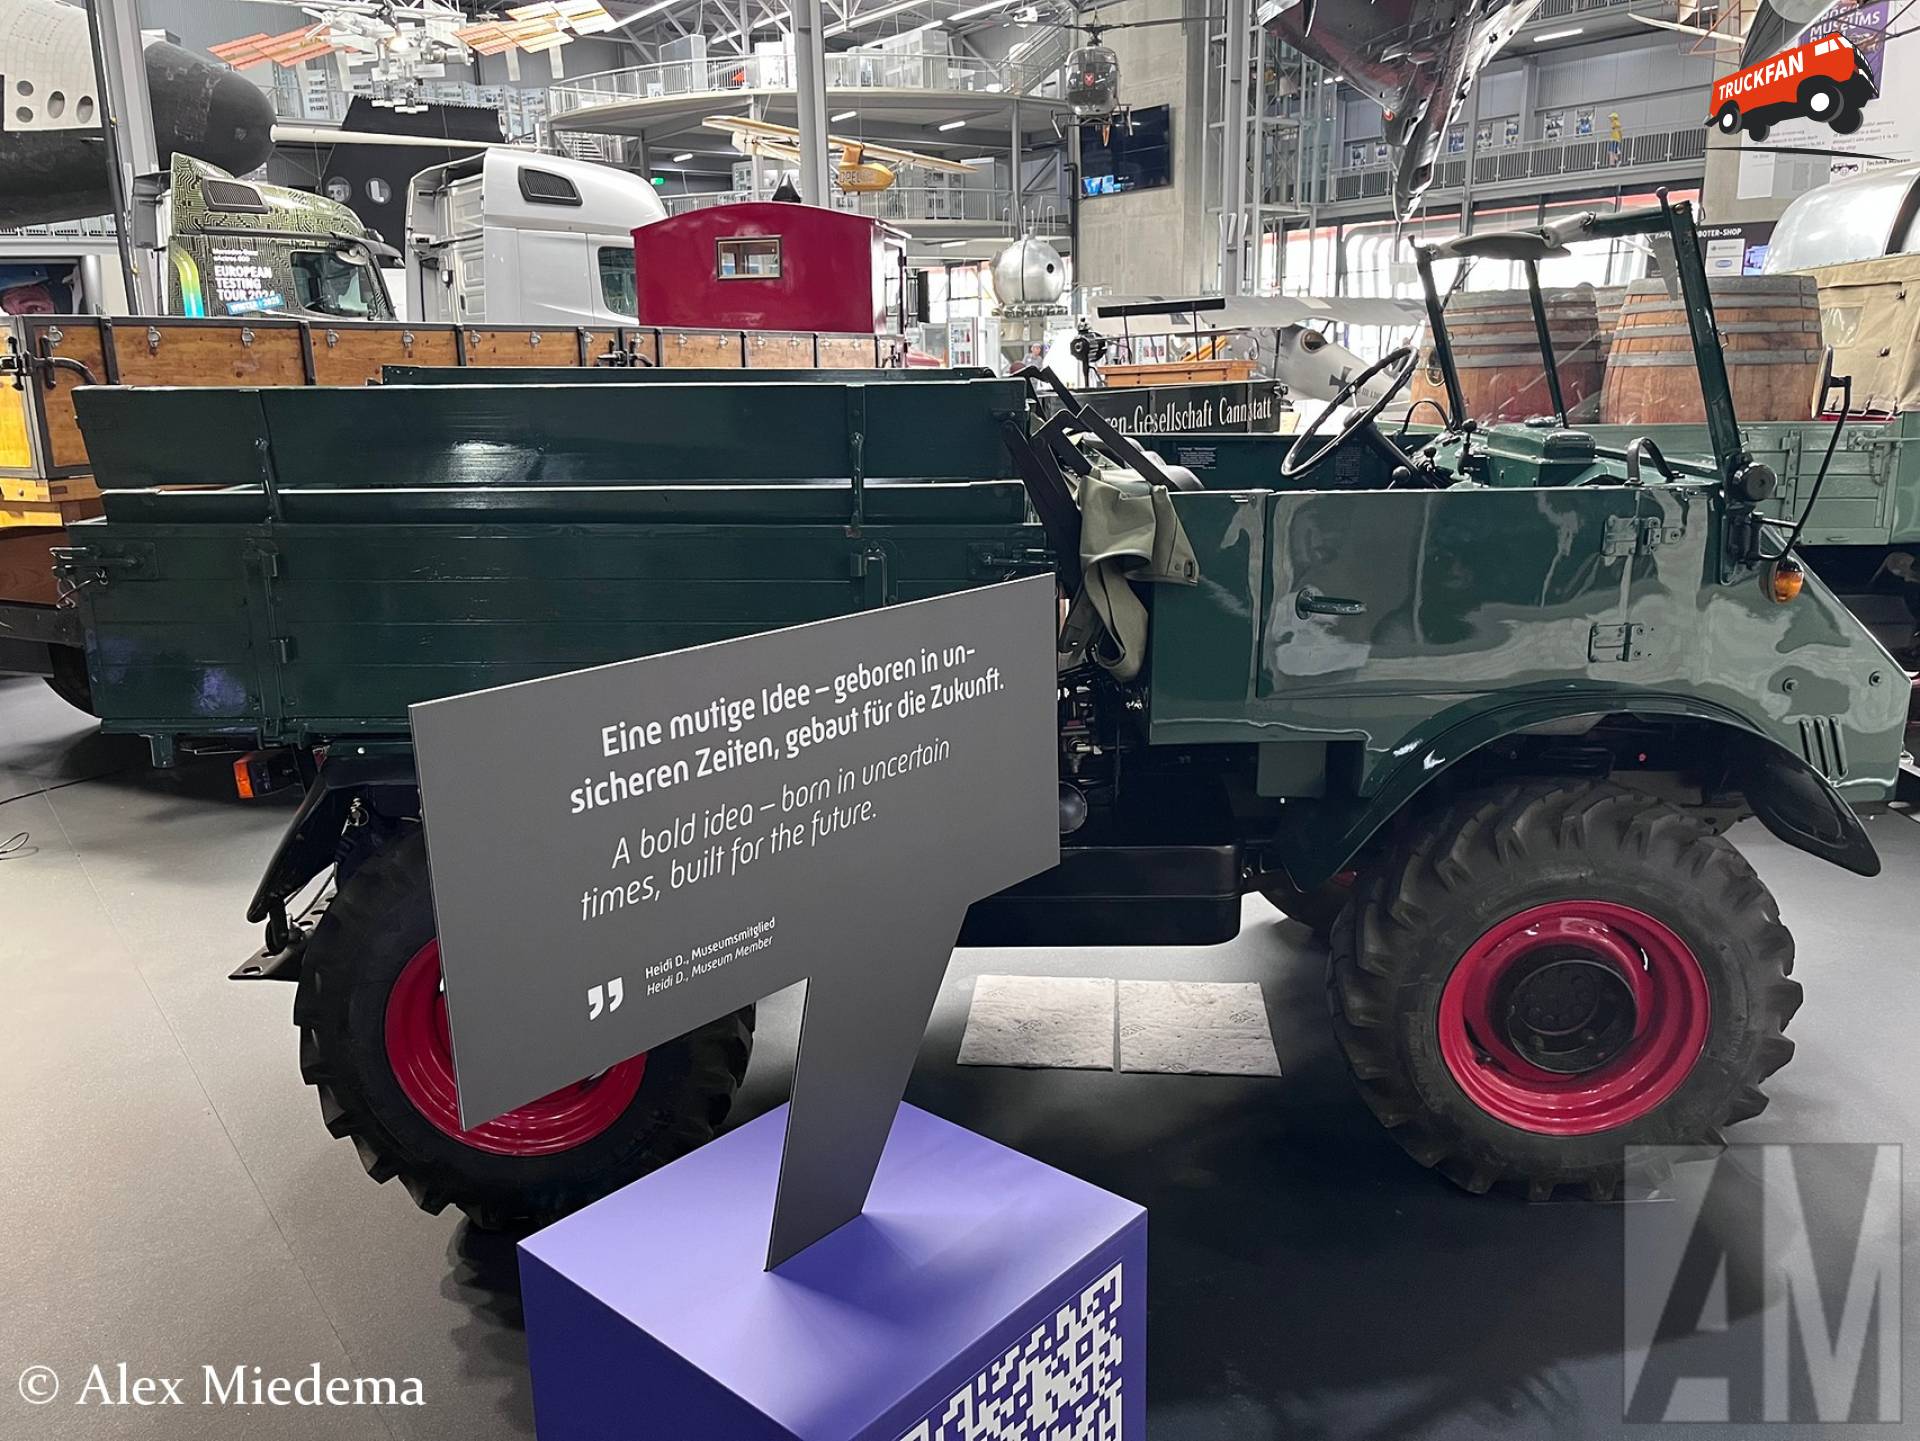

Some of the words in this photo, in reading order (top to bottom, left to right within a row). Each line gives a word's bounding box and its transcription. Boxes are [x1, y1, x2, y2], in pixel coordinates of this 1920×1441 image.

[214, 265, 273, 279] EUROPEAN
[215, 277, 262, 290] TESTING
[216, 288, 247, 301] TOUR
[1218, 396, 1272, 425] Cannstatt
[601, 722, 663, 758] Eine
[669, 696, 757, 739] mutige
[761, 681, 811, 717] Idee
[833, 656, 917, 704] geboren
[920, 648, 939, 675] in
[942, 643, 976, 670] un-
[569, 758, 690, 815] sicheren
[694, 733, 780, 779] Zeiten,
[785, 708, 860, 760] gebaut
[862, 696, 894, 733] für
[896, 690, 927, 719] die
[930, 668, 1005, 711] Zukunft.
[611, 837, 631, 869] A
[640, 812, 696, 859] bold
[703, 802, 753, 839] idea
[781, 777, 830, 812] born
[837, 768, 856, 791] in
[861, 738, 951, 786] uncertain
[580, 874, 661, 921] times,
[670, 846, 725, 889] built
[730, 837, 765, 877] for
[770, 822, 805, 855] the
[811, 800, 878, 848] future.
[644, 956, 674, 980] Heidi
[675, 952, 690, 968] D.,
[690, 916, 777, 960] Museumsmitglied
[646, 972, 674, 997] Heidi
[675, 968, 690, 984] D.,
[690, 953, 734, 979] Museum
[734, 934, 774, 961] Member
